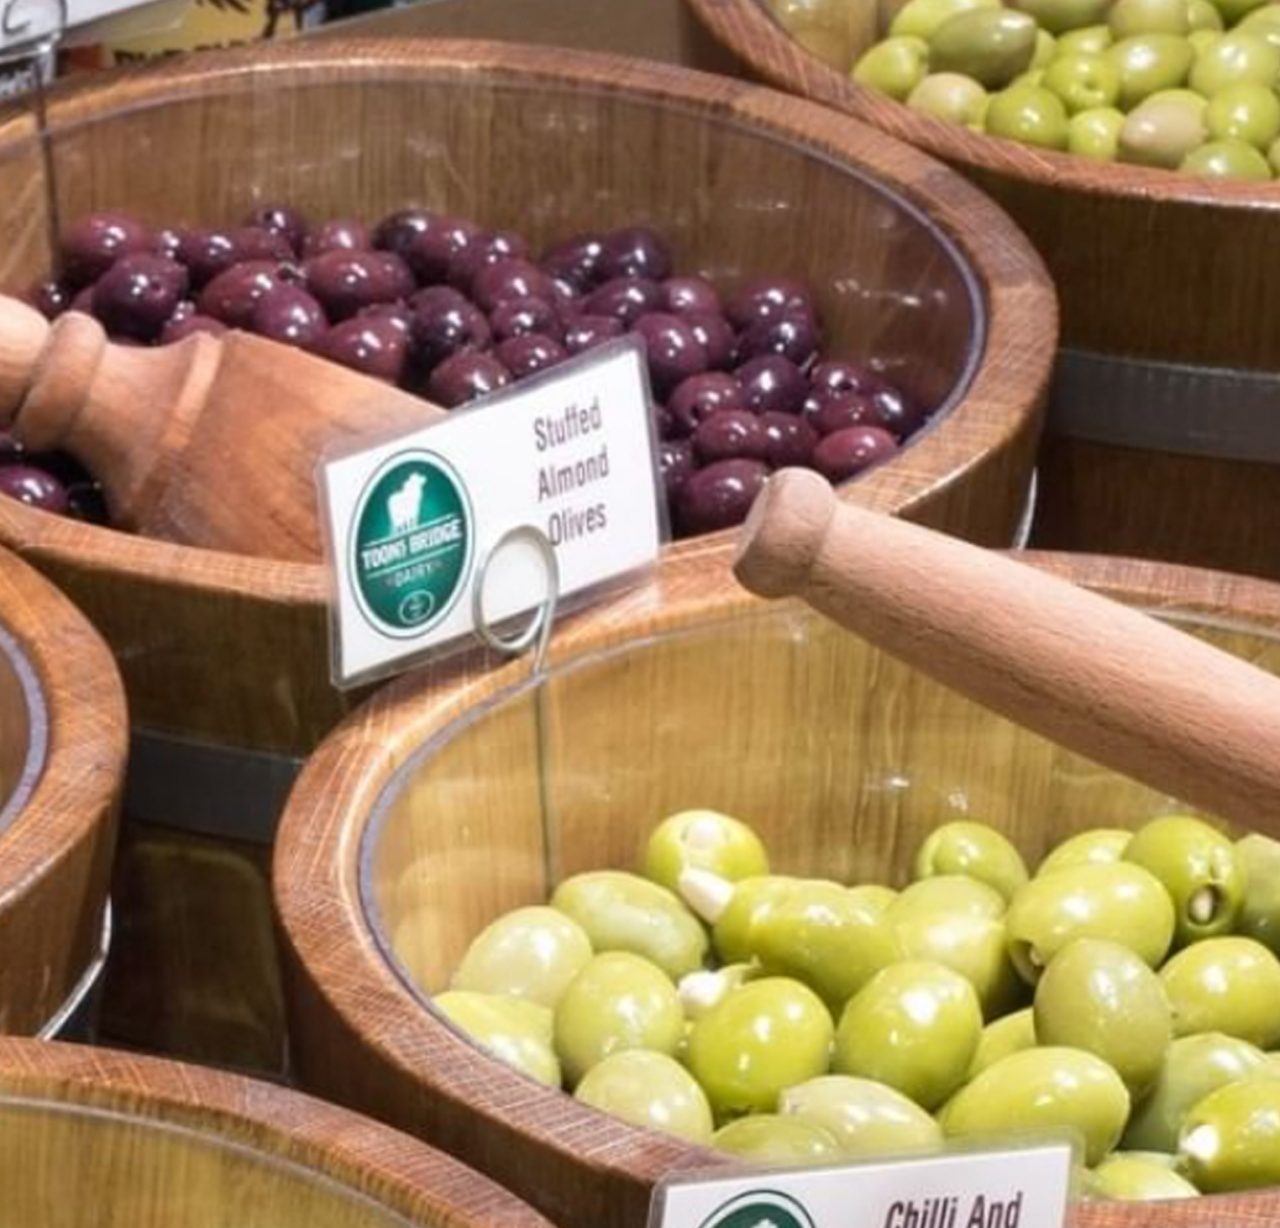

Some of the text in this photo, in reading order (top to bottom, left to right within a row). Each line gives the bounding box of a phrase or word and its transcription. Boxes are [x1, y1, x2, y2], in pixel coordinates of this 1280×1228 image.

[534, 396, 602, 453] Stuffed
[538, 445, 609, 503] Almond
[409, 519, 462, 555] BRIDGE
[548, 503, 607, 547] Olives
